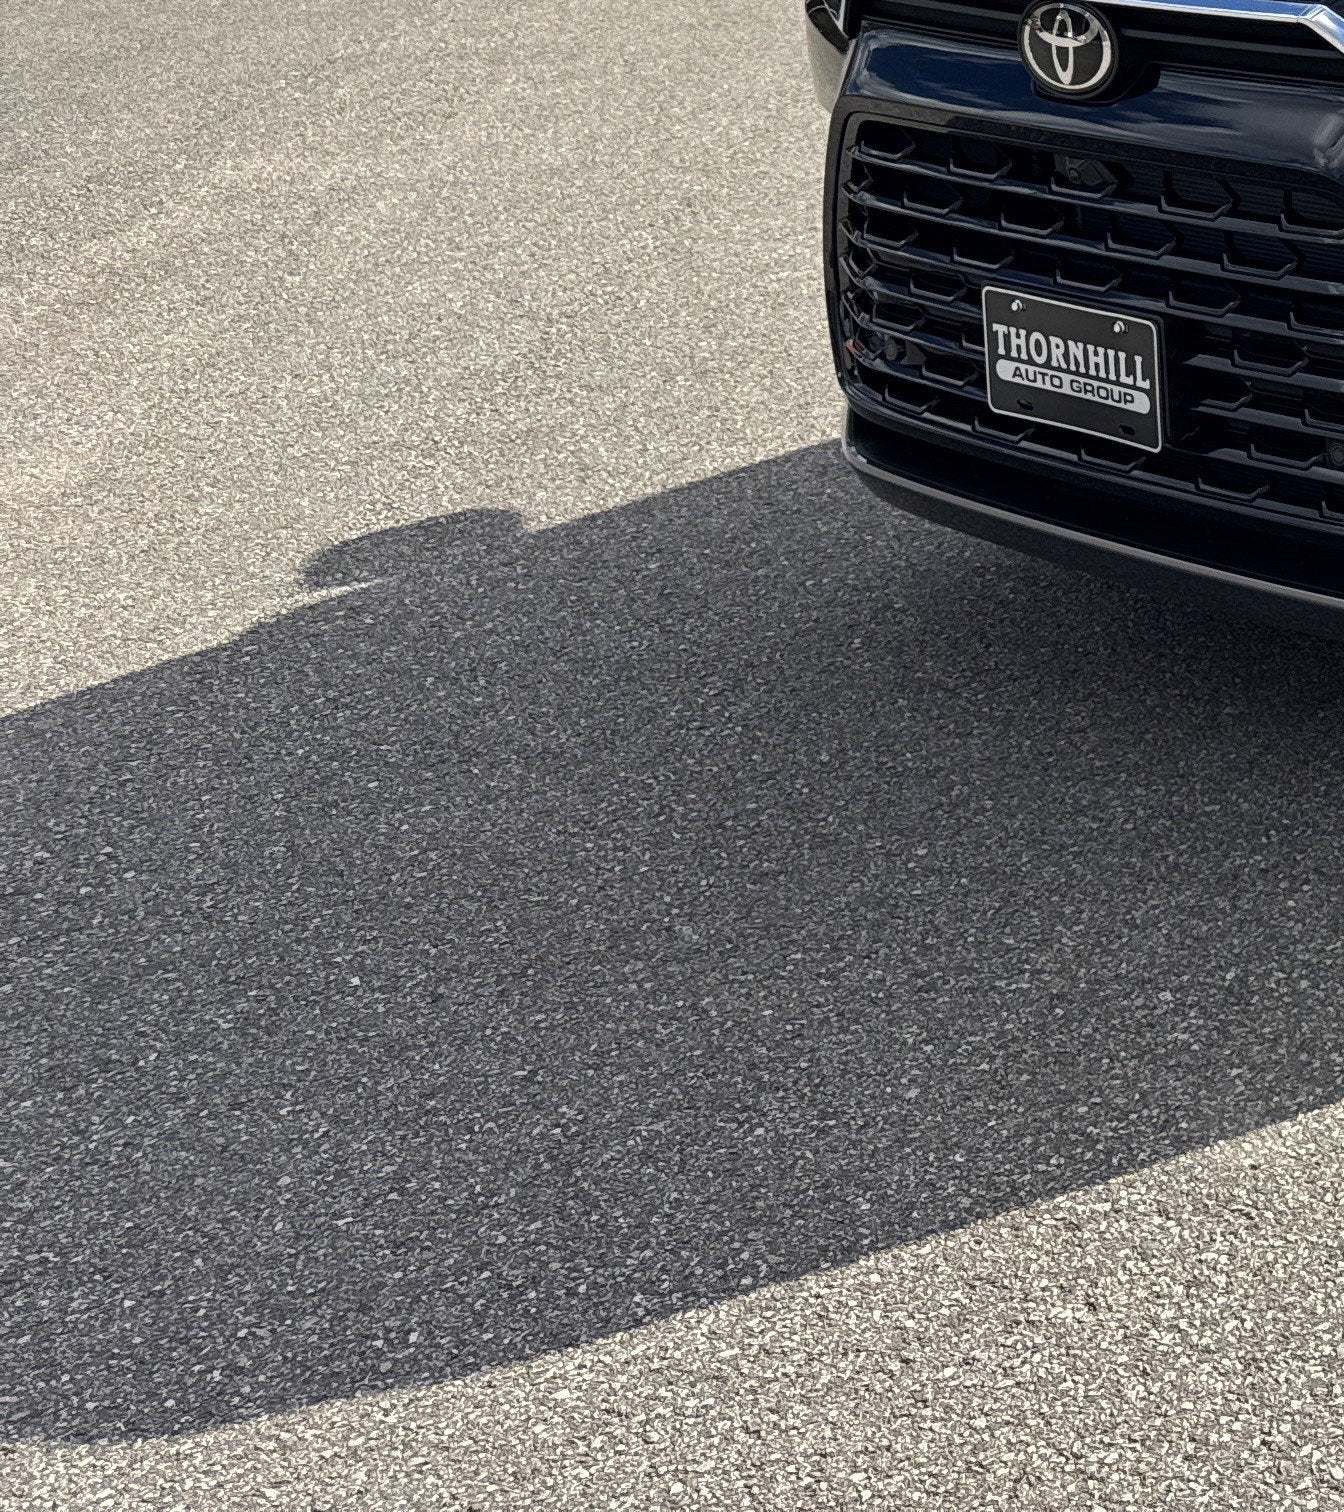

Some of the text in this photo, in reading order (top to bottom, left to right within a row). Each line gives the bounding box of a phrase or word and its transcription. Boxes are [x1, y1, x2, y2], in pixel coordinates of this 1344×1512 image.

[992, 323, 1150, 389] THORNHILL
[1012, 366, 1134, 405] AUTO GROUP
